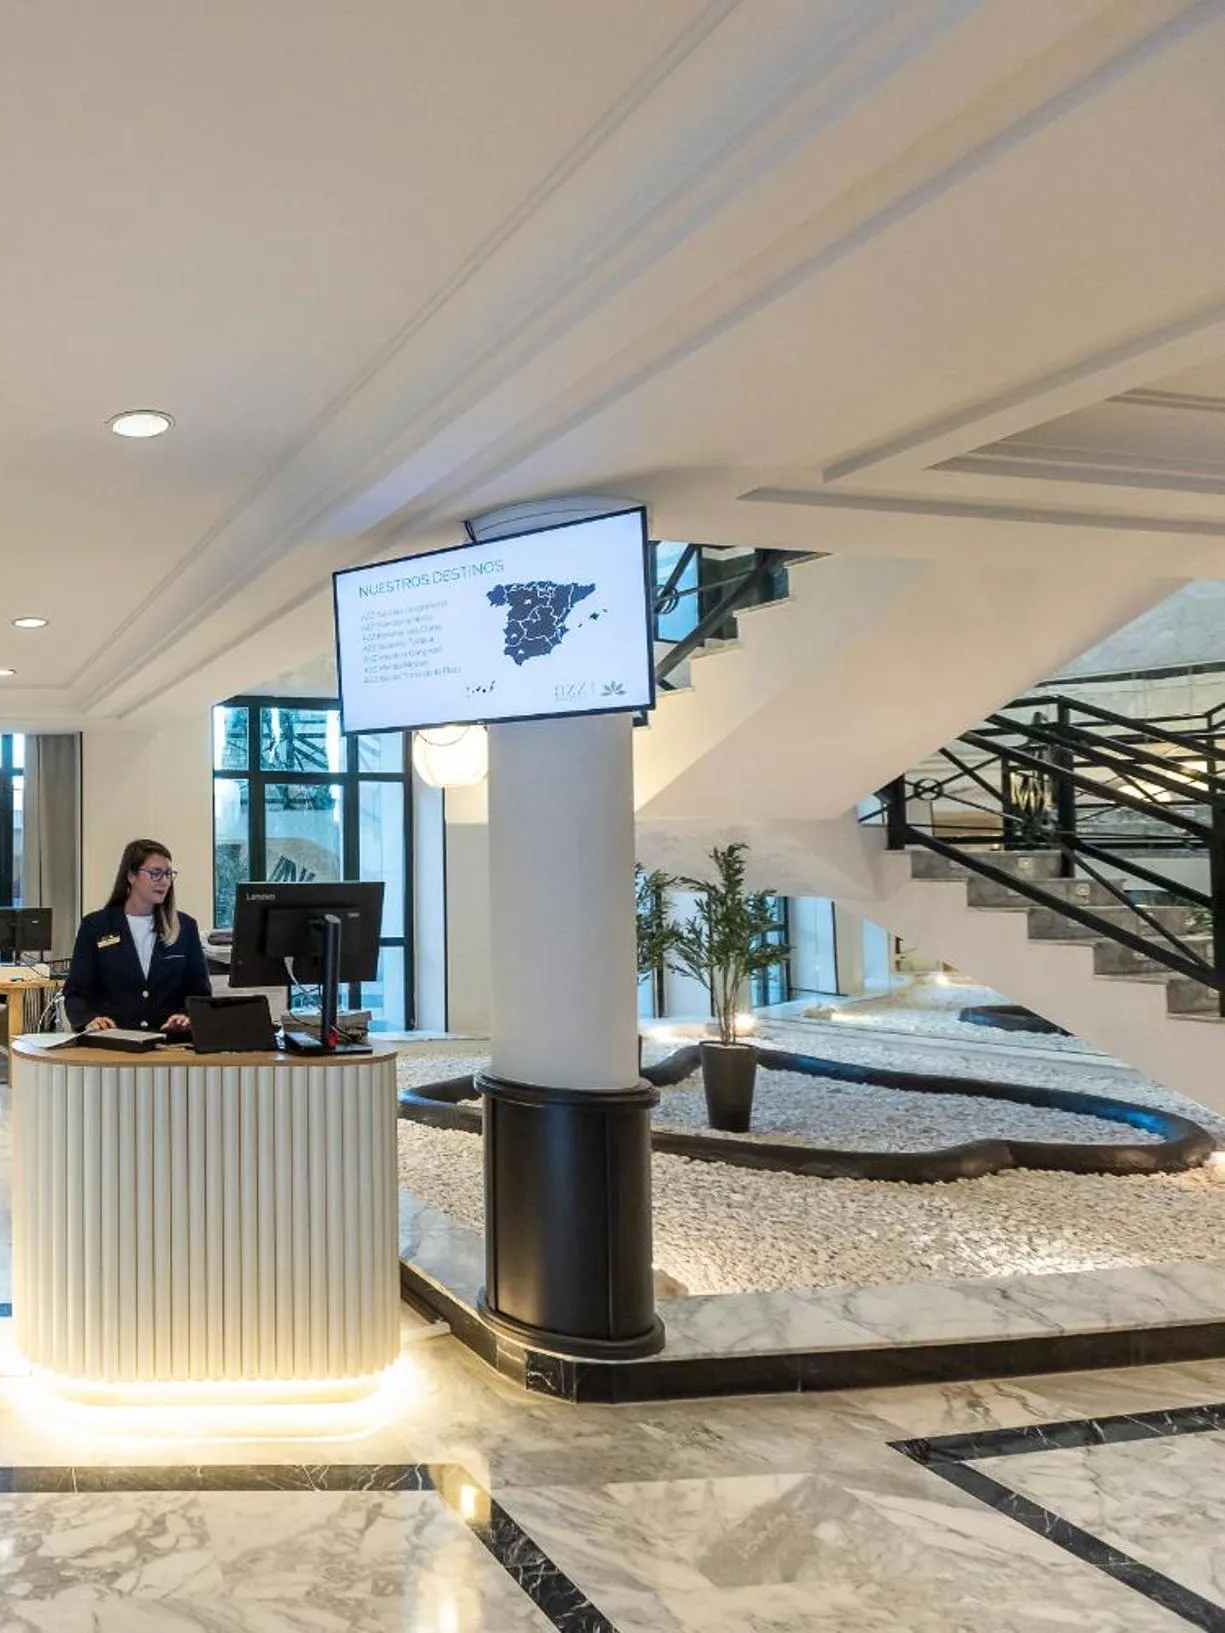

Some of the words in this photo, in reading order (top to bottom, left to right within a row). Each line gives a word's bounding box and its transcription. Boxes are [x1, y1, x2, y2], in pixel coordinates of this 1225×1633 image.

[359, 573, 430, 598] NUESTROS
[432, 559, 505, 584] DESTINOS
[246, 893, 276, 901] Lenovo
